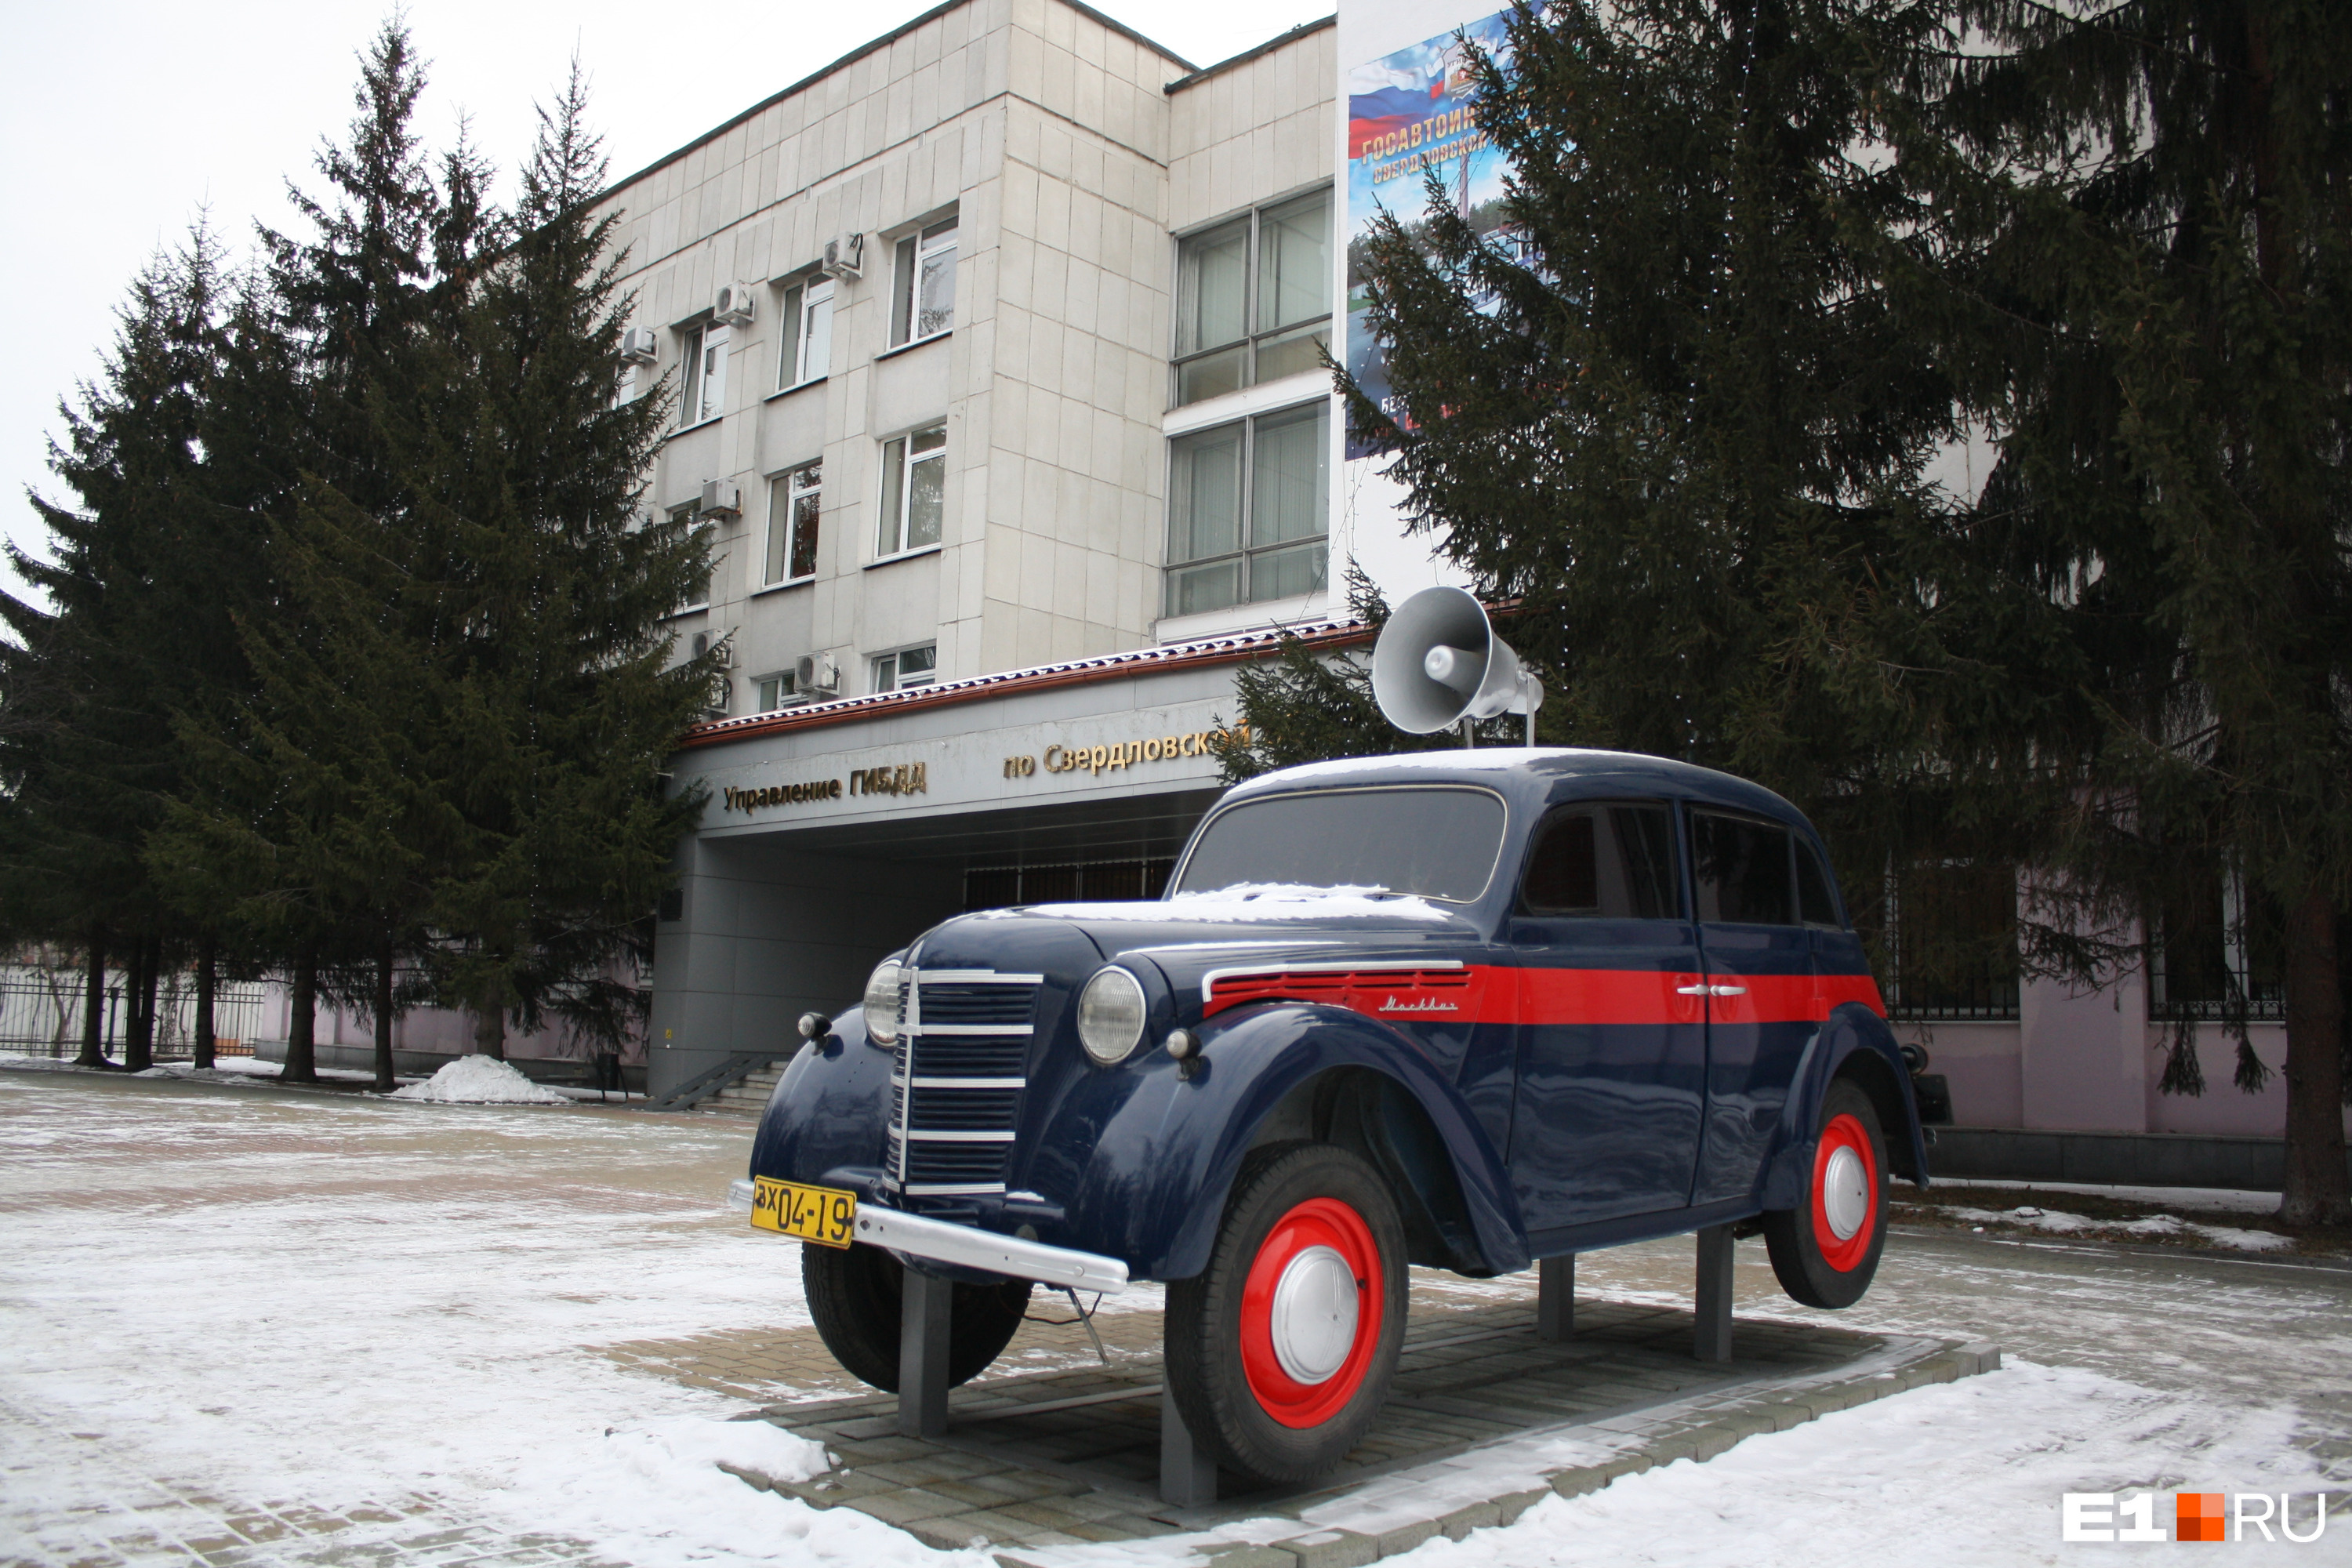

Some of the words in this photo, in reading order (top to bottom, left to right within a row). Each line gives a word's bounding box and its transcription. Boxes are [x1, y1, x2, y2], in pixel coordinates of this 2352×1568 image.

[1362, 105, 1475, 165] ГОСАВТОИН
[724, 779, 842, 815] Управление
[850, 761, 927, 797] ГИБДД
[1003, 755, 1035, 779] по
[1378, 995, 1458, 1011] Москвич
